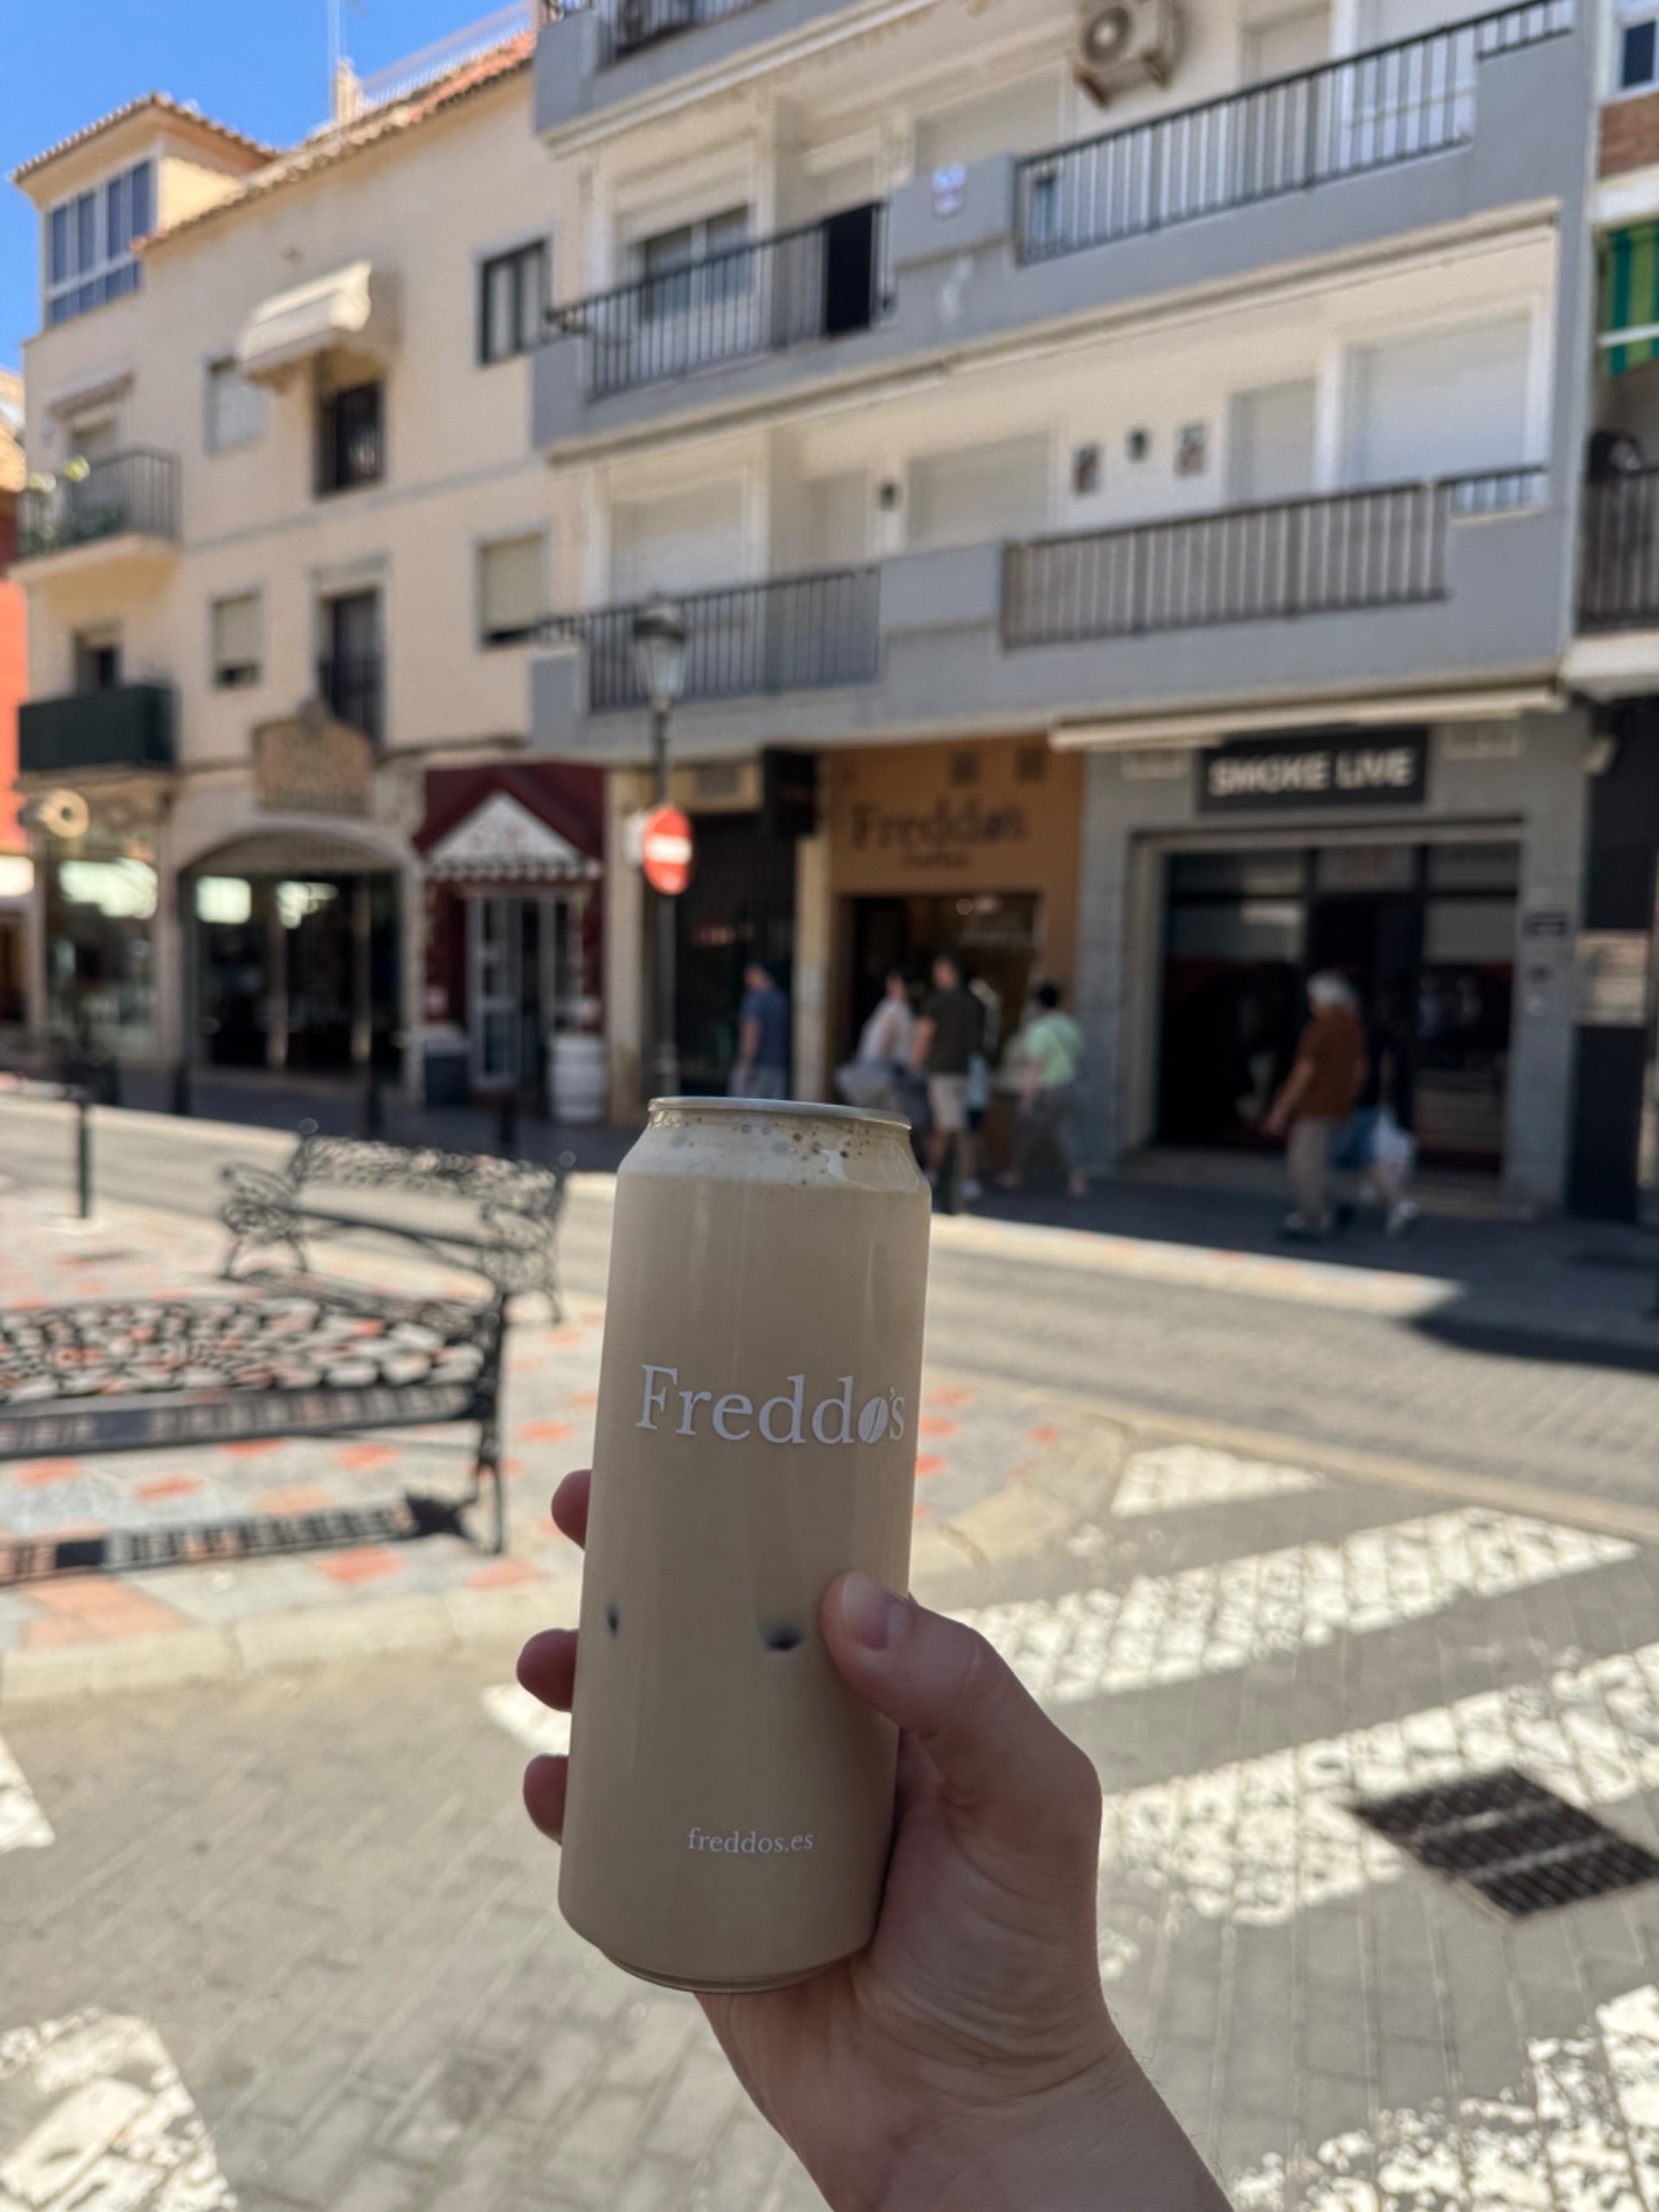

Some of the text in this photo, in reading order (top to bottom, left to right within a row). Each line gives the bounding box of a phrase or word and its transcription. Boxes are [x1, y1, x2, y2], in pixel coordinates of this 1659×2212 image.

[1210, 747, 1414, 796] SMOKE LIVE
[636, 1363, 906, 1445] Freddo's
[688, 1826, 814, 1853] freddos.es
